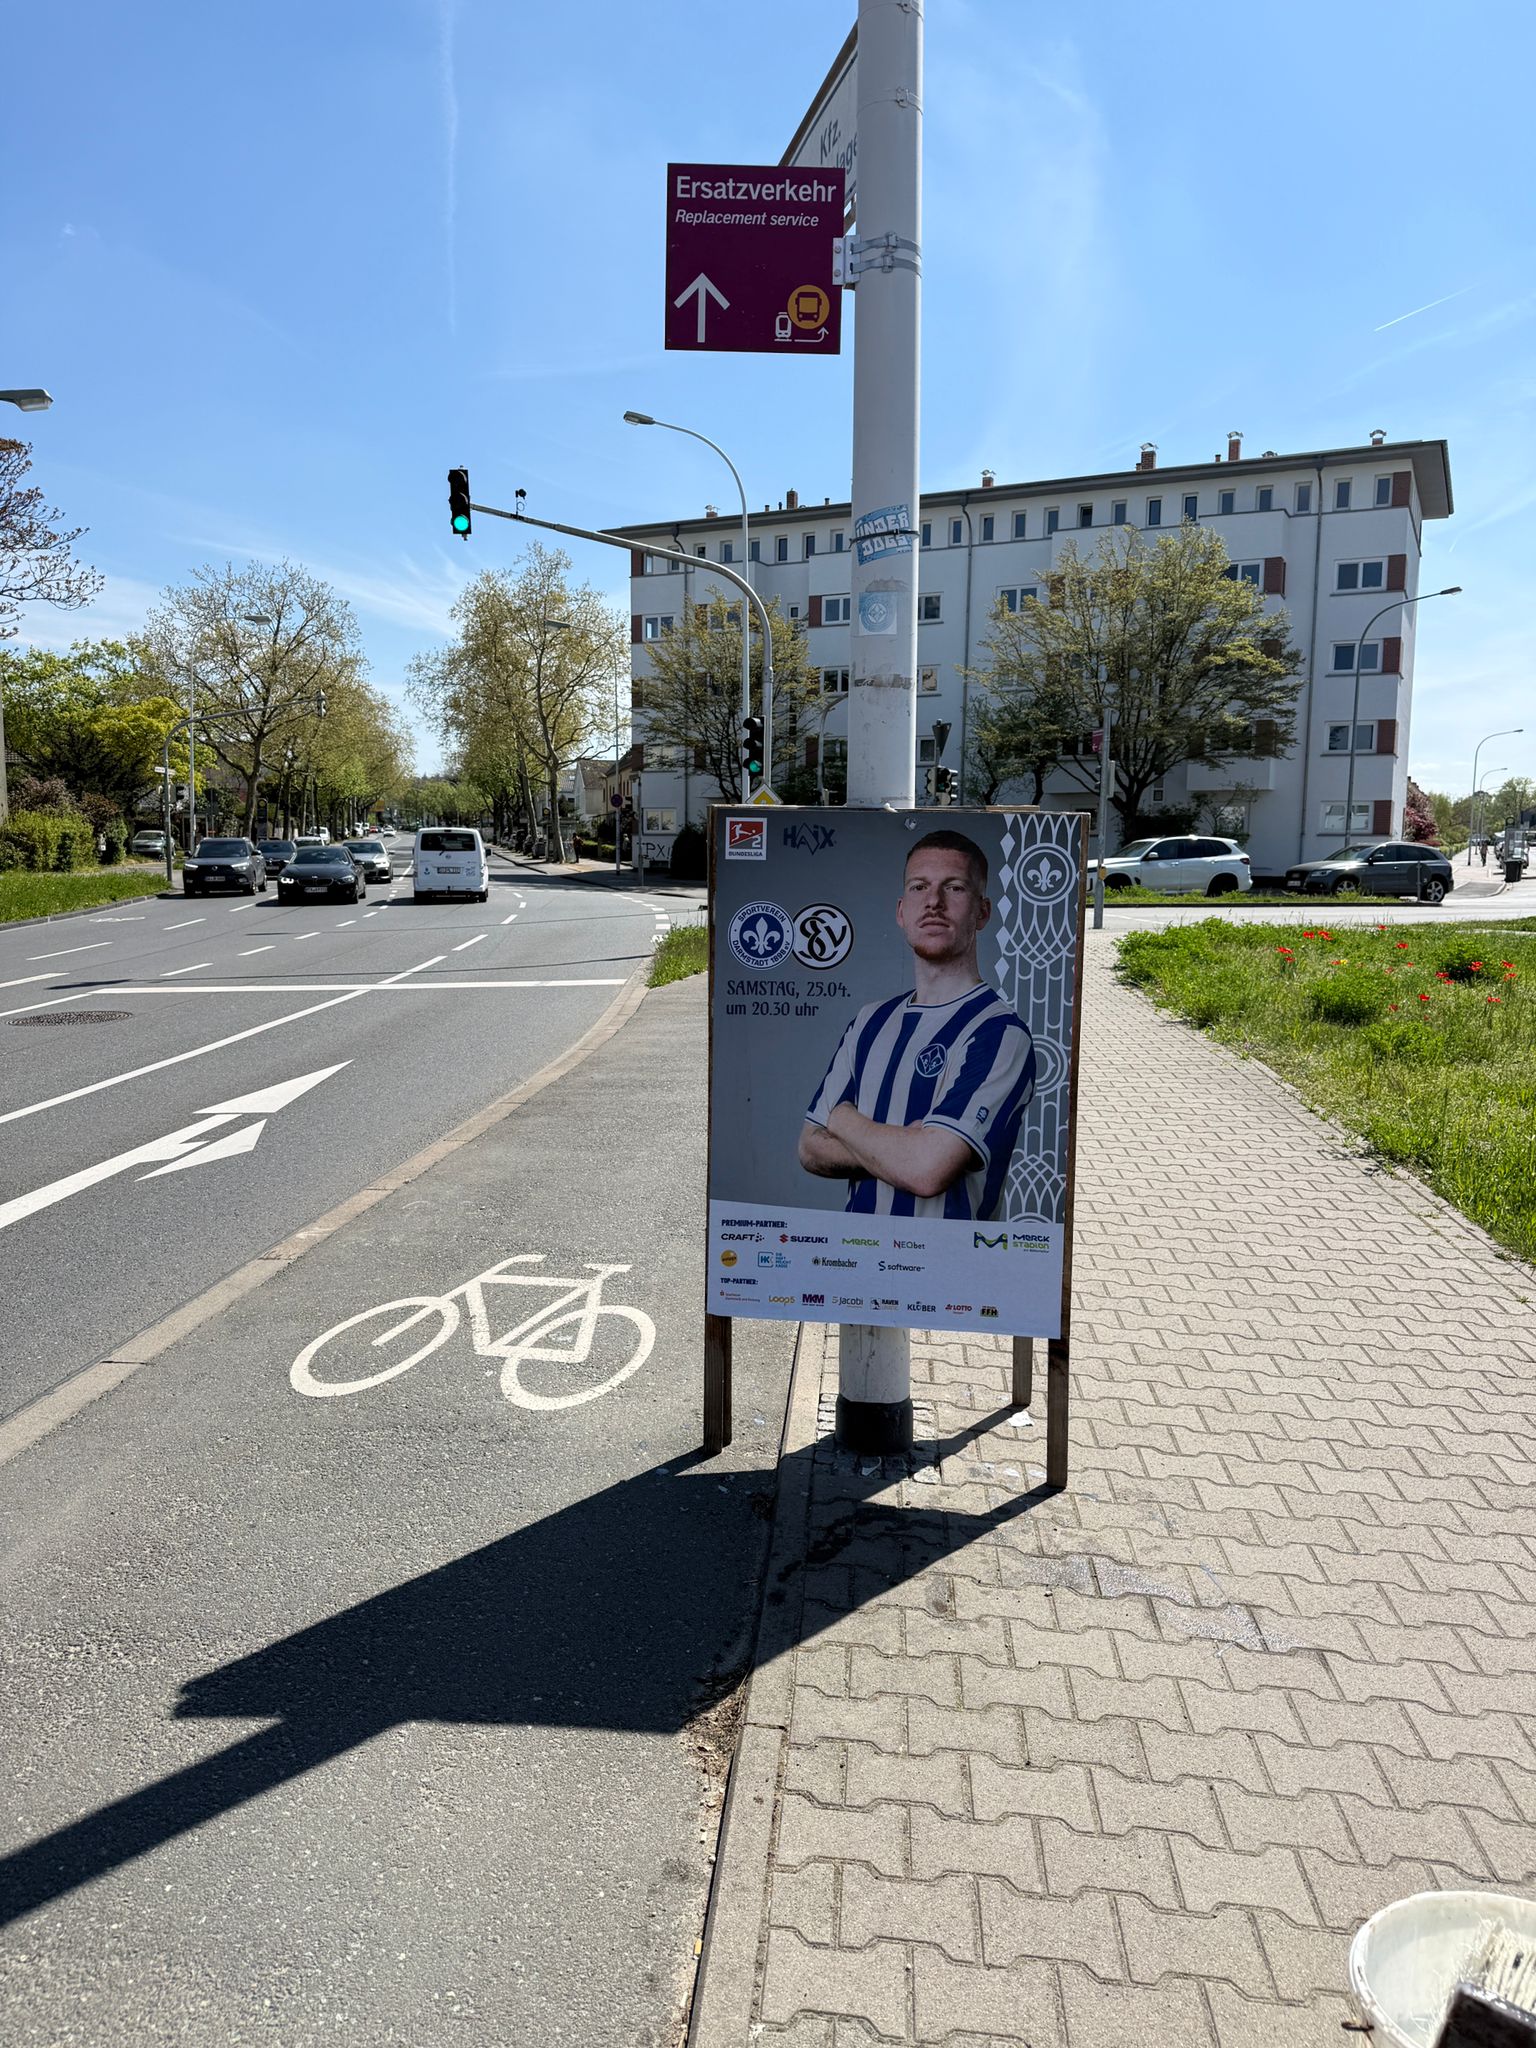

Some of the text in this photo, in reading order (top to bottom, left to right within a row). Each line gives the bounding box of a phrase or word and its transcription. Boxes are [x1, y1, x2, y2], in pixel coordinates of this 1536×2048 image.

[820, 119, 842, 165] Kfz.
[675, 175, 837, 204] Ersatzverkehr
[675, 209, 820, 228] Replacement service
[728, 850, 763, 858] BUNDESLIGA
[737, 904, 787, 923] SPORTVEREIN
[732, 939, 770, 967] DARMSTADT
[770, 948, 787, 964] 1898
[726, 980, 852, 999] SAMSTAG, 25.04.
[726, 1001, 819, 1017] um 20.30 uhr
[721, 1218, 788, 1229] PREMIUM-PARTNER:
[720, 1232, 756, 1242] CRAFT
[790, 1235, 829, 1244] SUZUKI
[821, 1257, 858, 1269] Krombacher
[720, 1277, 759, 1285] TOP-PARTNER:
[838, 1296, 864, 1306] Jacobi
[953, 1304, 973, 1312] LOTTO
